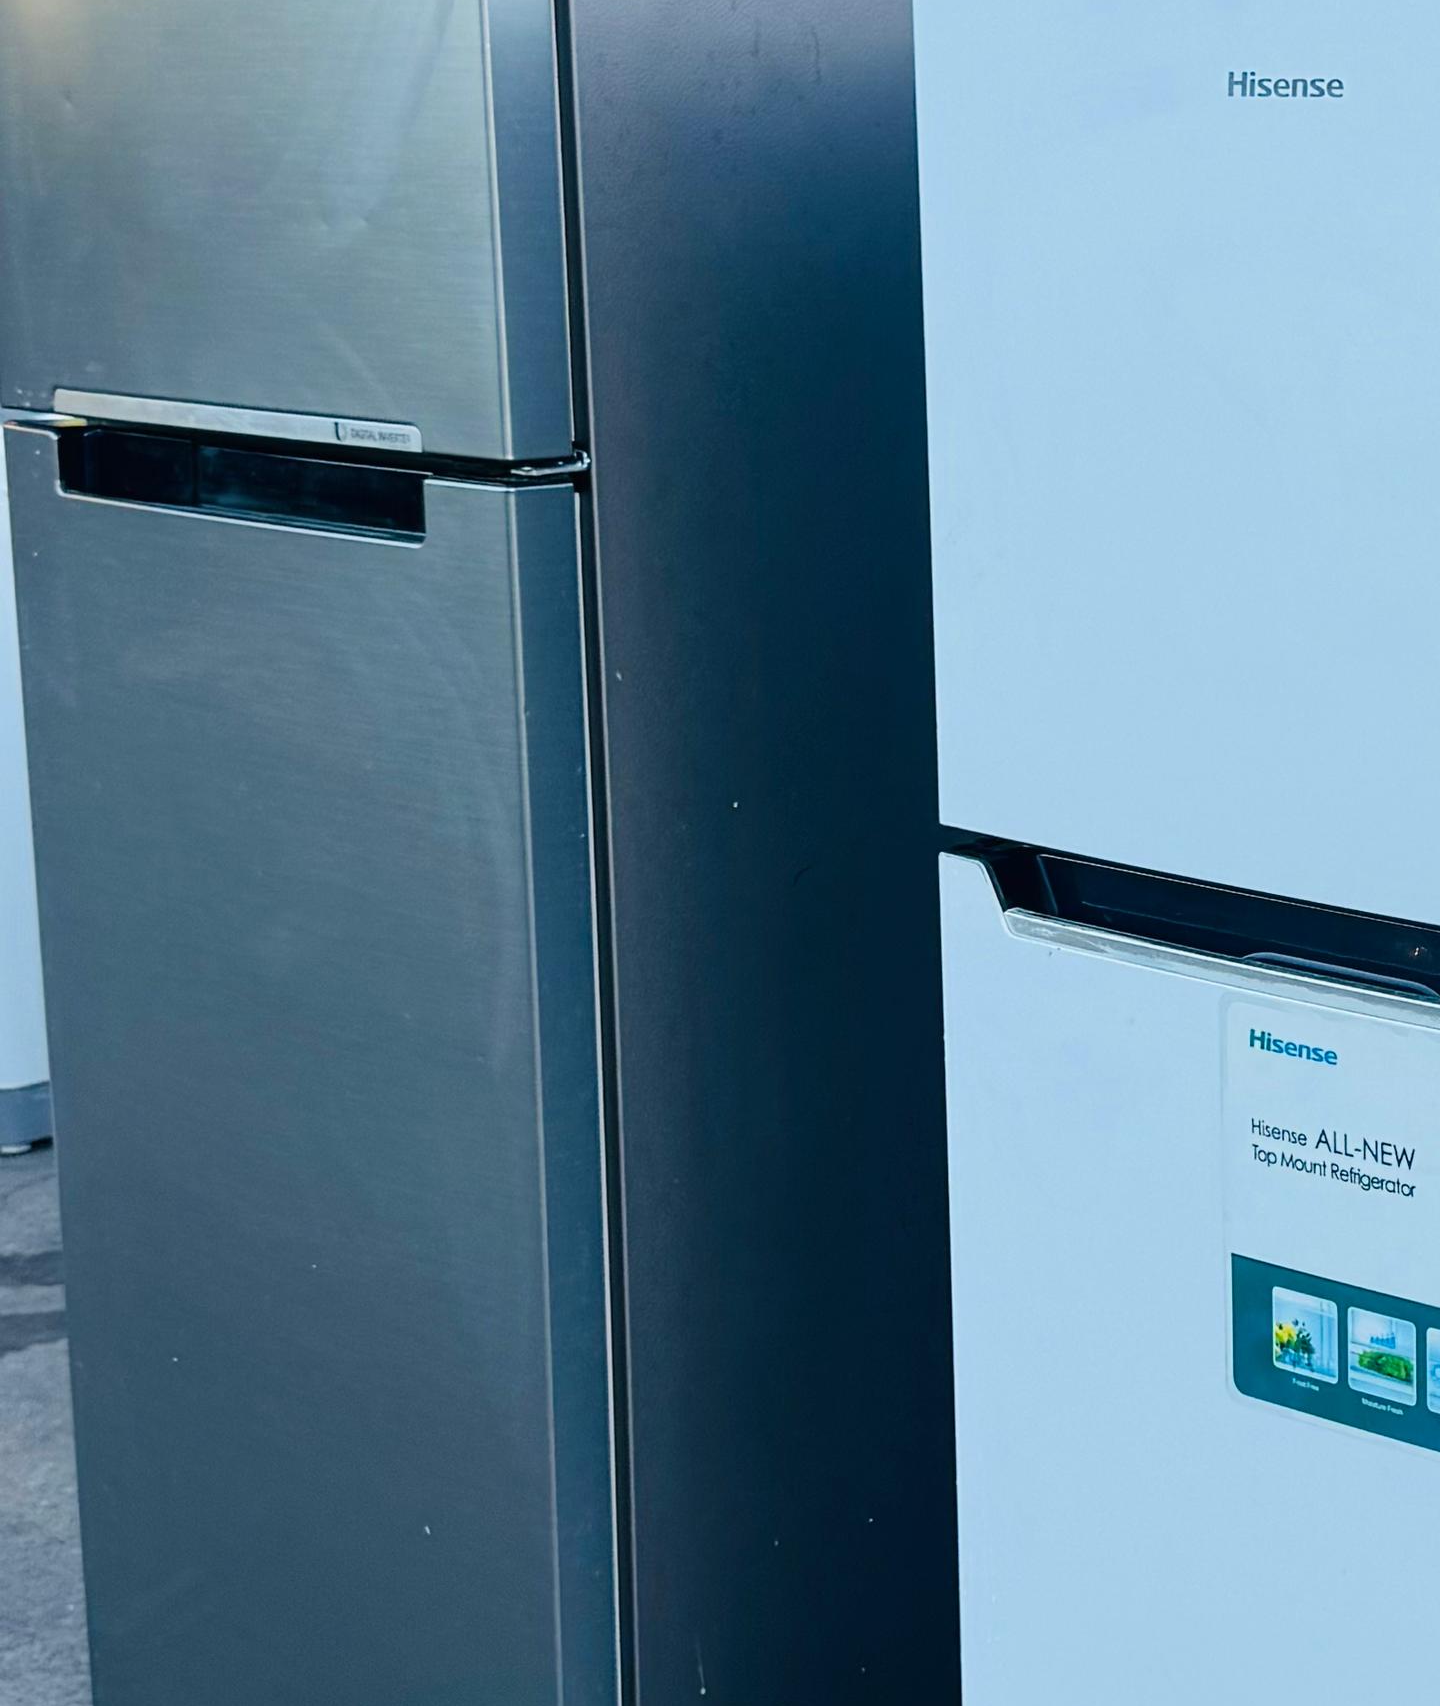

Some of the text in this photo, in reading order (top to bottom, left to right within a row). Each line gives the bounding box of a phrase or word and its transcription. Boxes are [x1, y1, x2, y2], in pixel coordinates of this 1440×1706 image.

[1227, 71, 1344, 98] Hisense
[1249, 1027, 1338, 1066] Hisense
[1251, 1117, 1415, 1171] Hisense ALL-NEW
[1252, 1143, 1416, 1198] Top Mount Refrigerator
